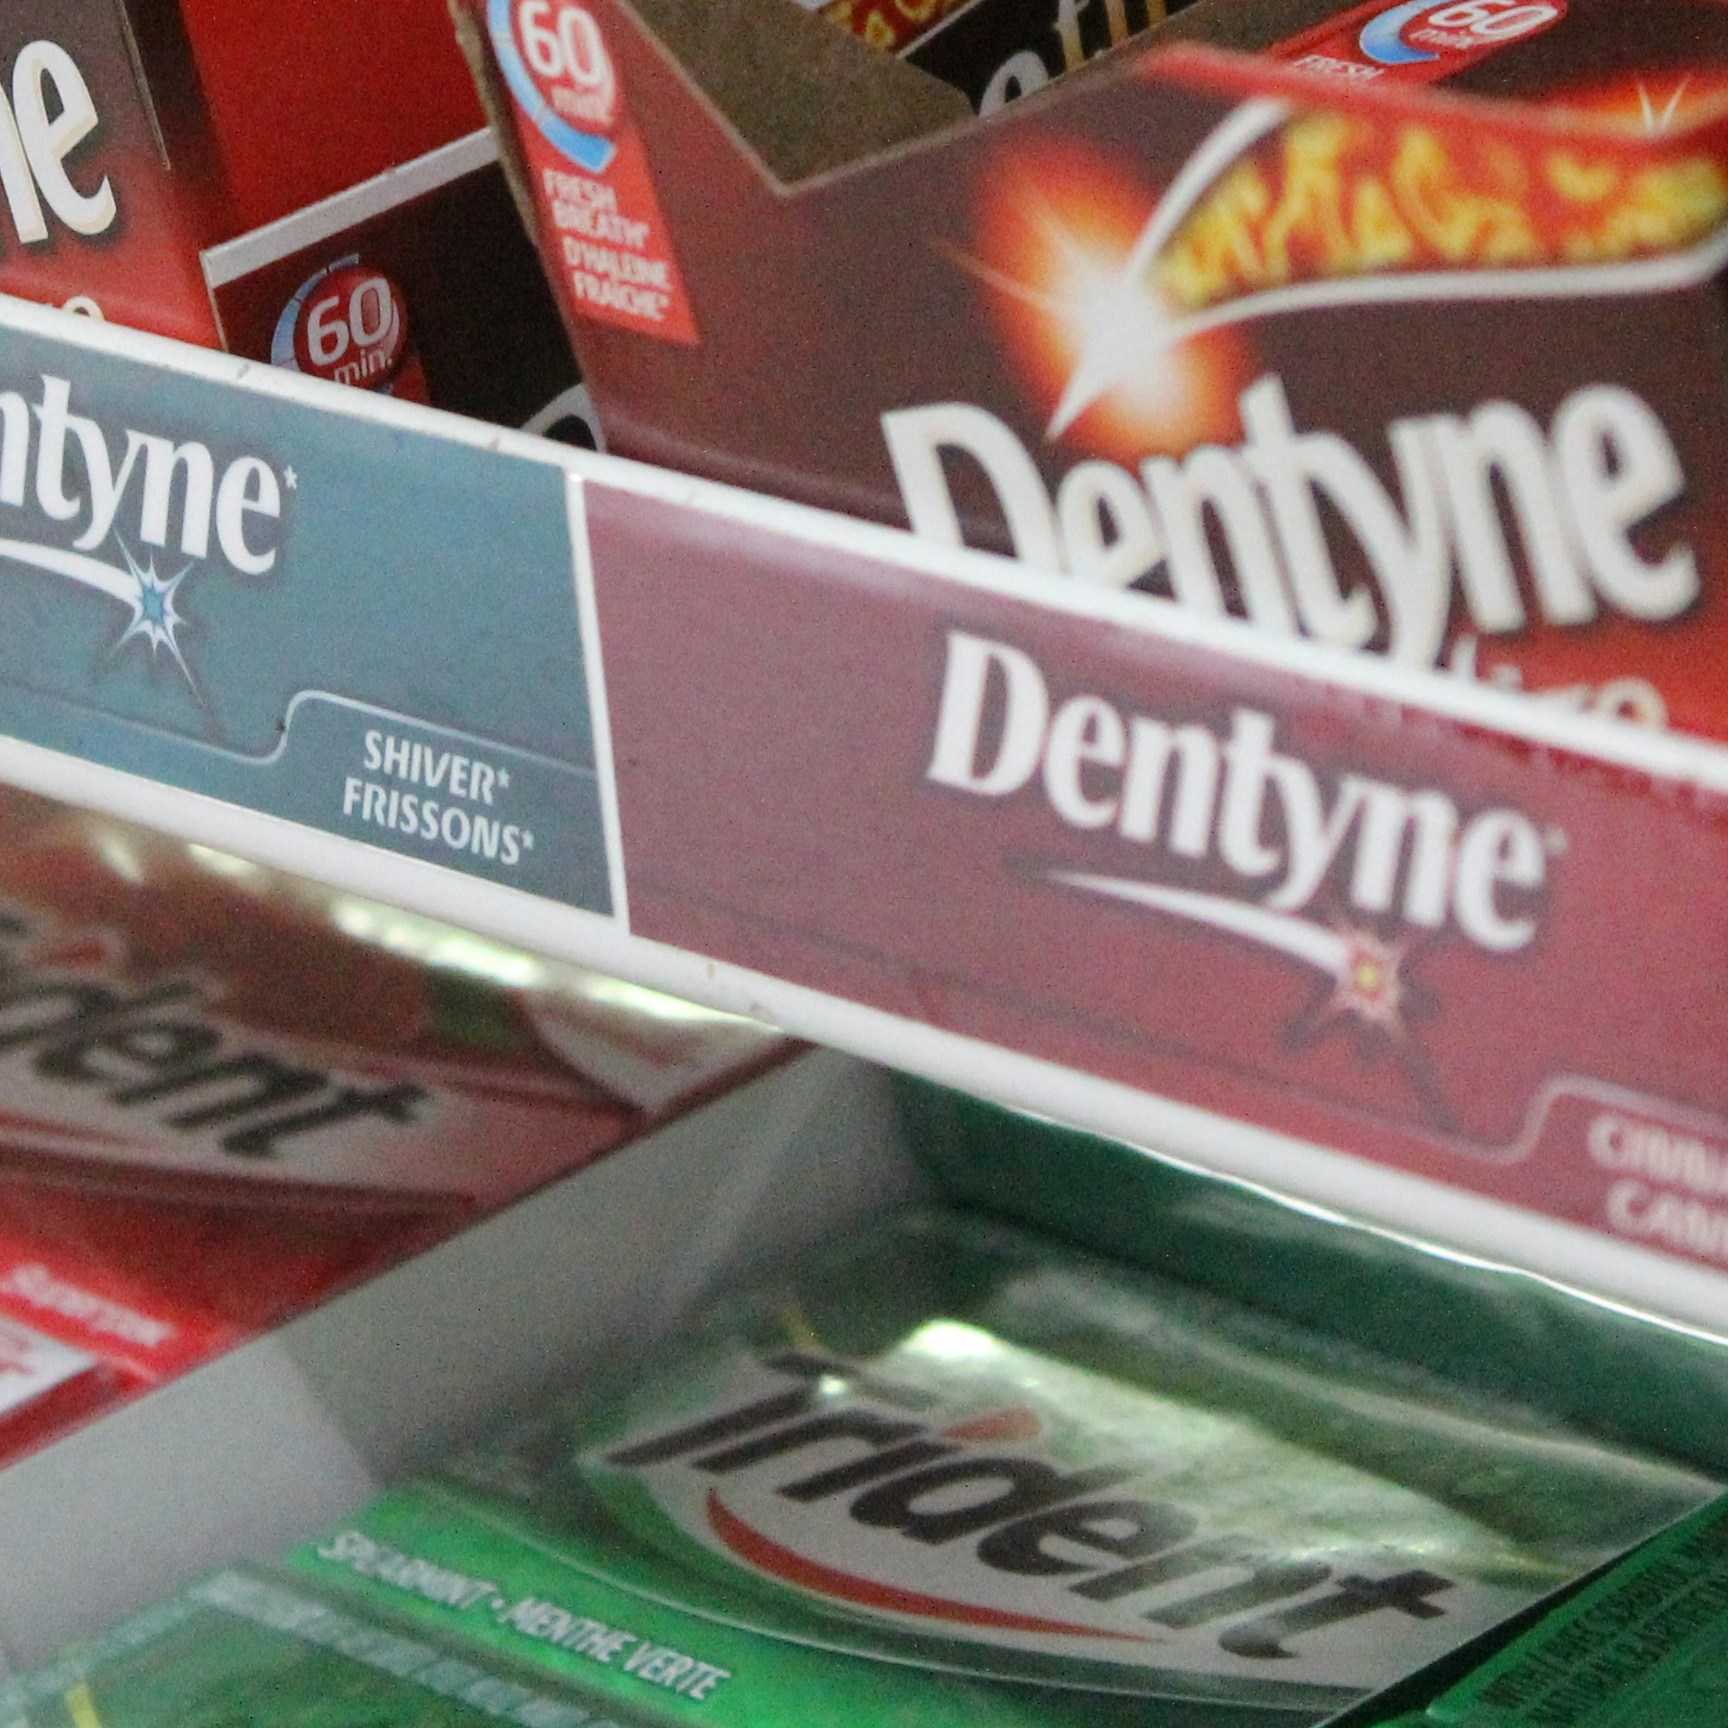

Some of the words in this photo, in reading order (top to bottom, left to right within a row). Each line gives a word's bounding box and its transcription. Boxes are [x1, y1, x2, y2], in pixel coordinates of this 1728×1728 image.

[307, 276, 393, 366] 60
[882, 373, 1702, 674] Dentyne
[926, 628, 1552, 953] Dentyne
[606, 1350, 1455, 1660] Trident
